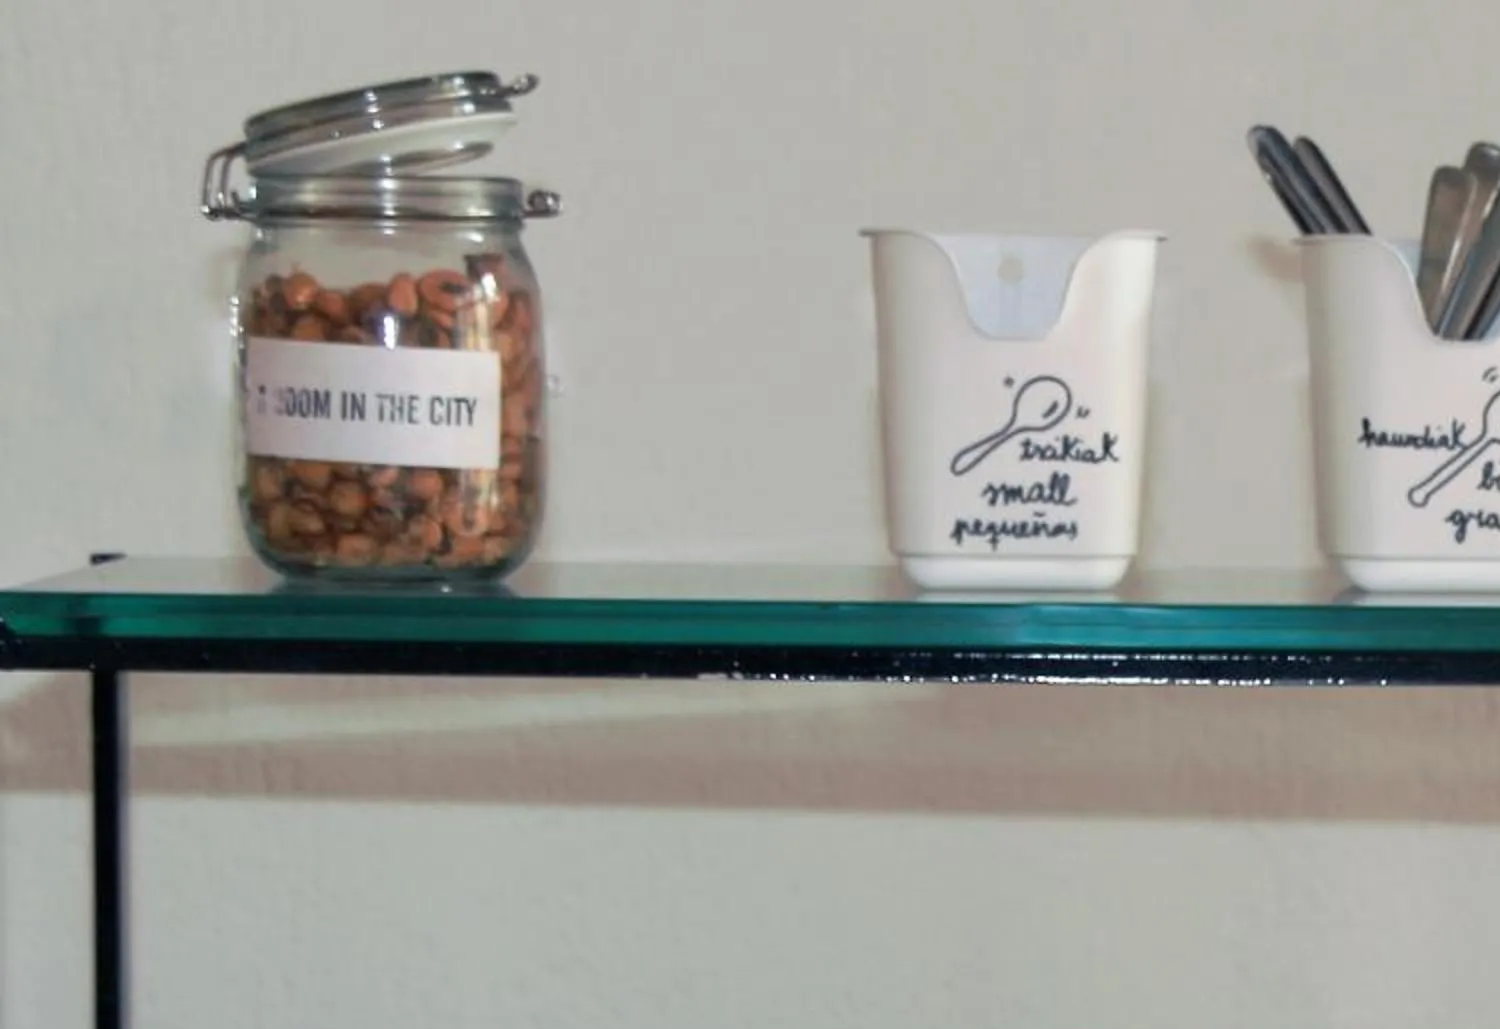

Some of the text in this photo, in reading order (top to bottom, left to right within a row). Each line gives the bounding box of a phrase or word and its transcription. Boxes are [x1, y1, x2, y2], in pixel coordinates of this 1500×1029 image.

[341, 390, 367, 422] IN
[374, 392, 420, 426] THE
[428, 394, 478, 427] CITY
[980, 470, 1078, 506] small
